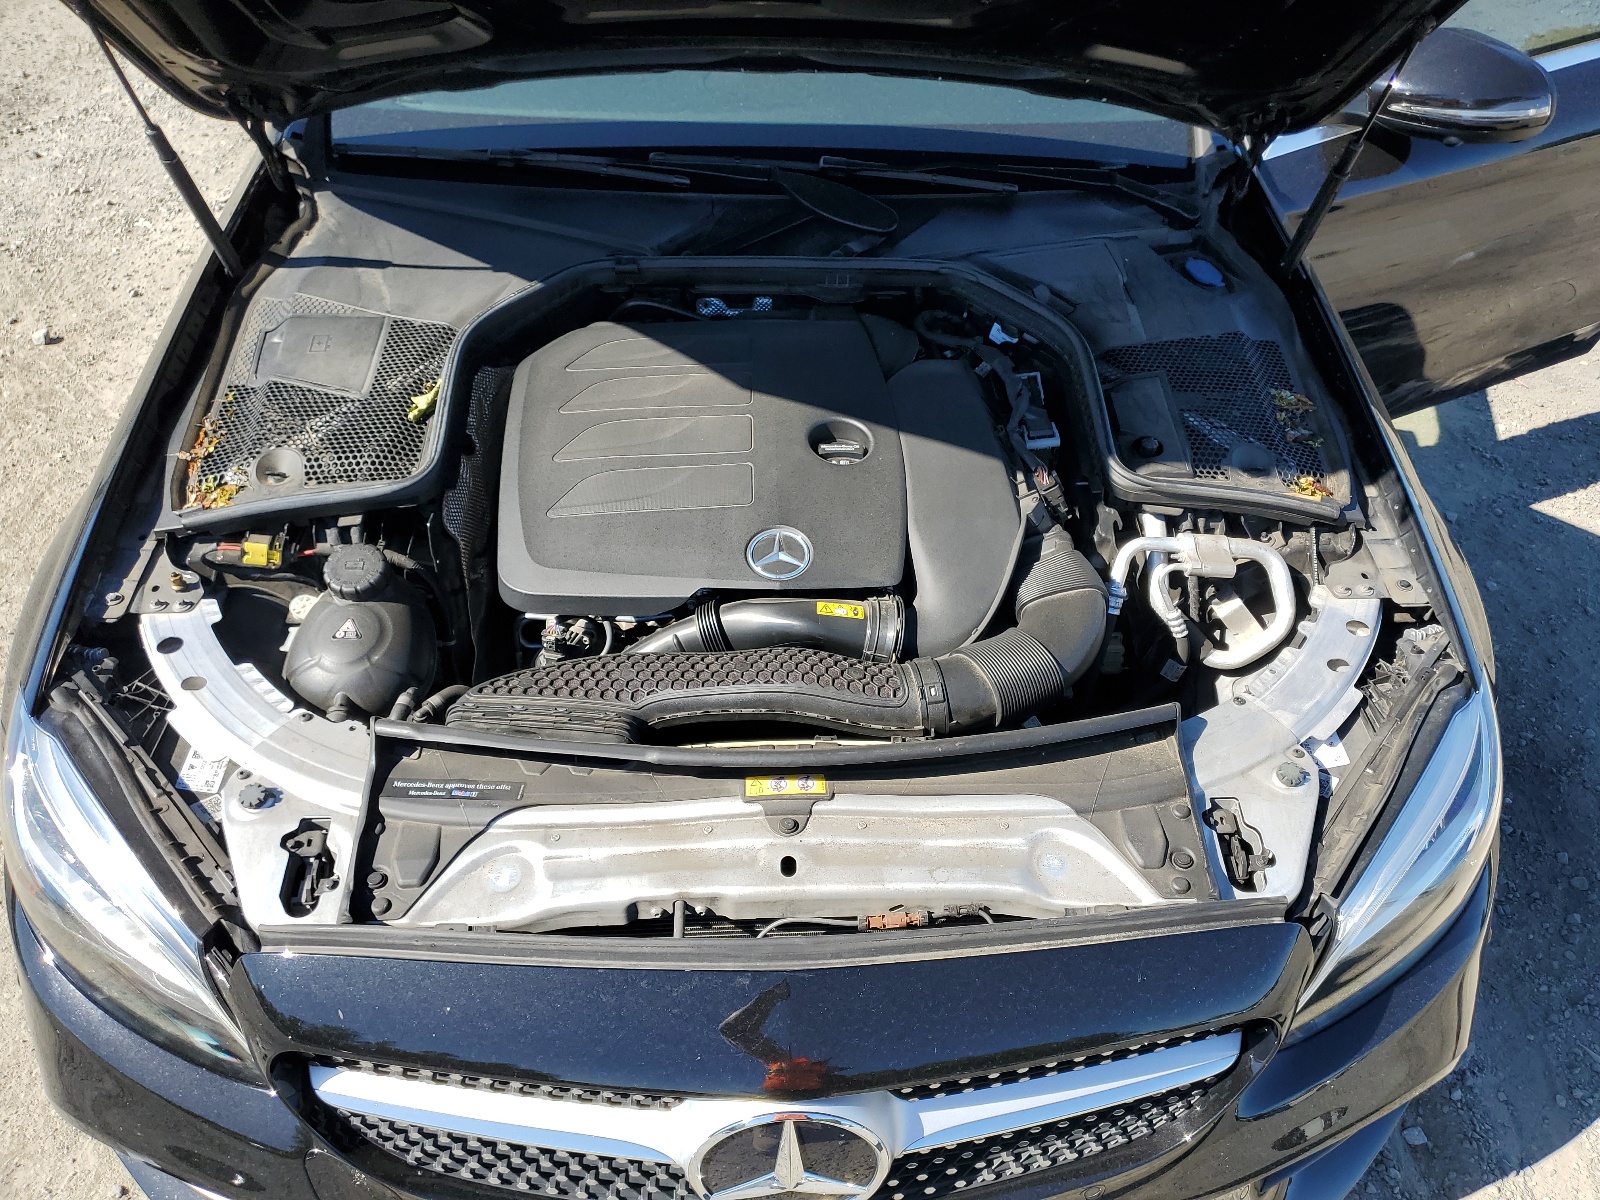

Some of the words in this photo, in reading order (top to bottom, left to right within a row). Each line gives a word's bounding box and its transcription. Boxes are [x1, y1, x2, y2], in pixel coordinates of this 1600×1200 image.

[392, 780, 444, 789] Mercedes-Benz
[445, 782, 475, 790] approves
[476, 782, 495, 790] these
